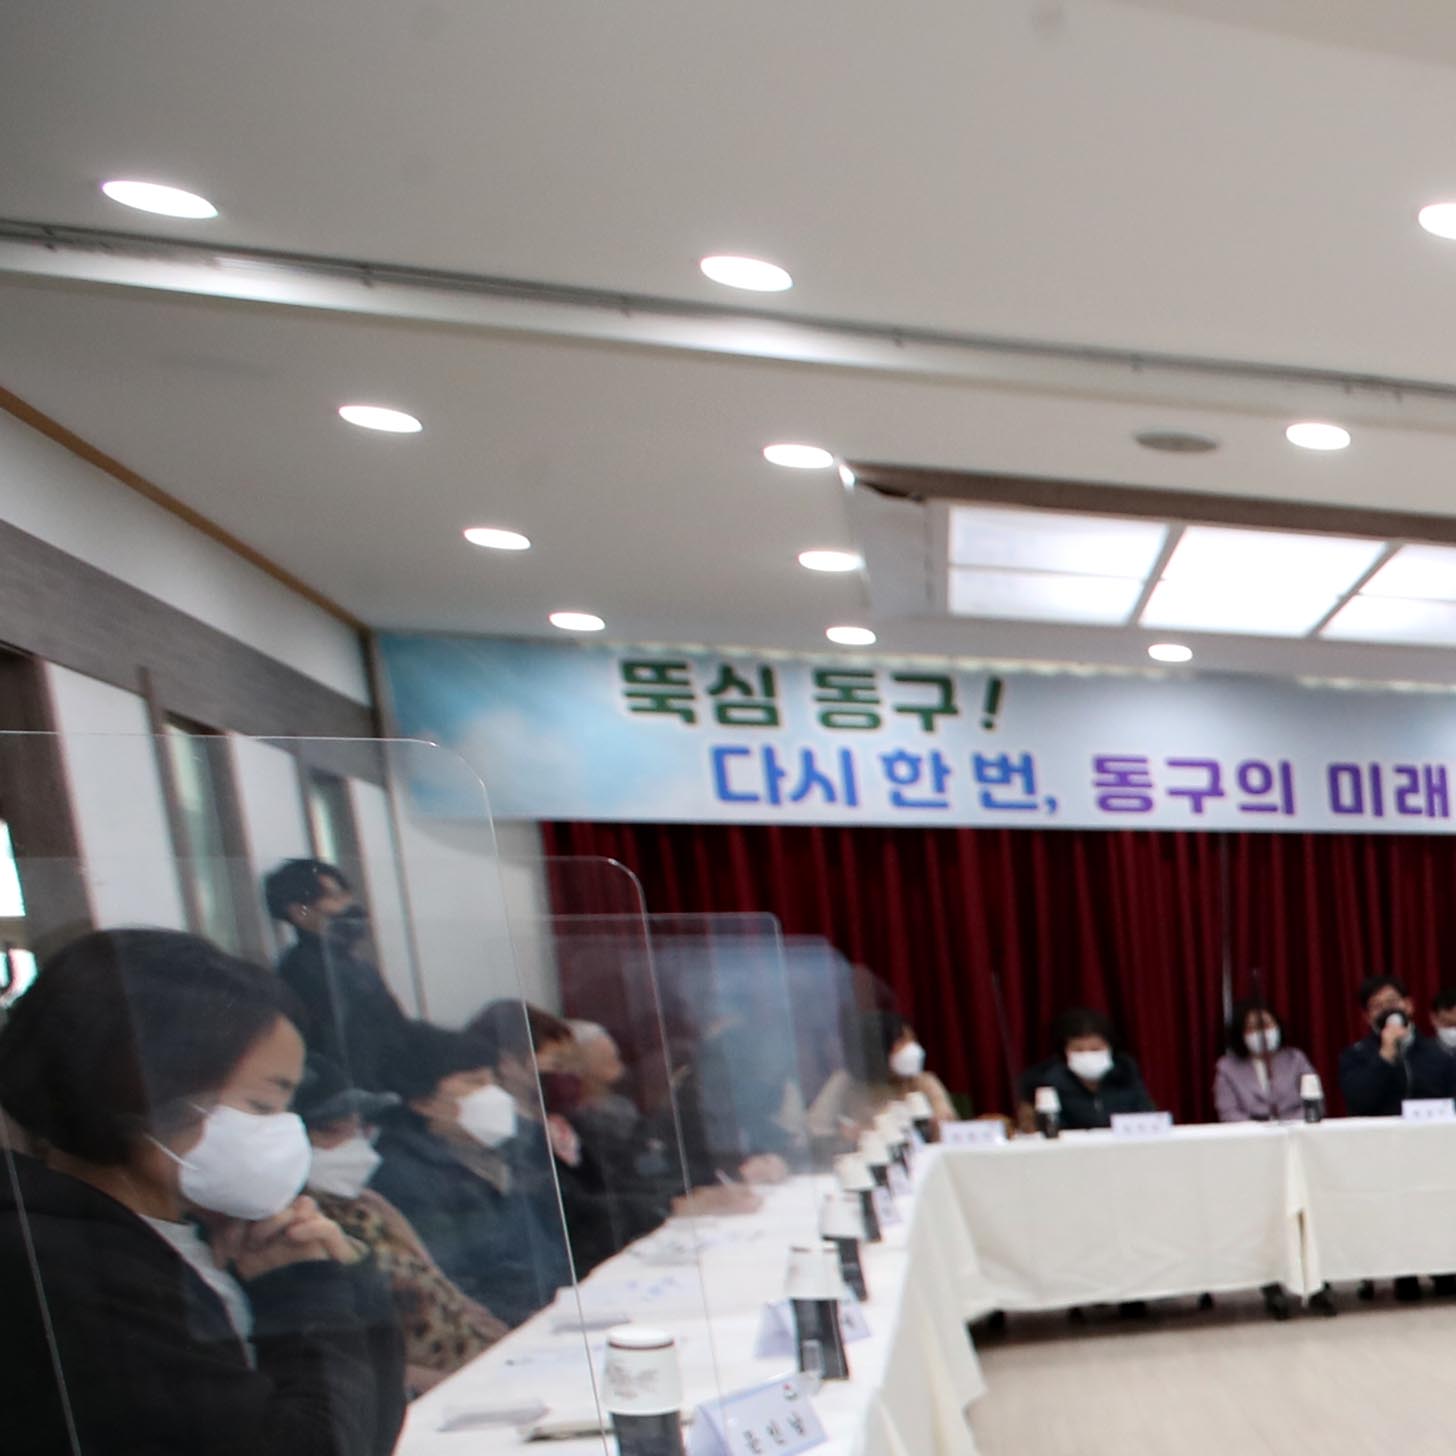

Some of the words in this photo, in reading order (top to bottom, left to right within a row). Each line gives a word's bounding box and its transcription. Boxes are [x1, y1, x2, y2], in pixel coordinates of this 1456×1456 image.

[619, 659, 779, 727] 뚝심
[812, 668, 1004, 733] 동구!
[711, 744, 860, 808] 다시
[880, 747, 951, 810] 한
[973, 751, 1057, 817] 번,
[1092, 754, 1296, 816] 동구의
